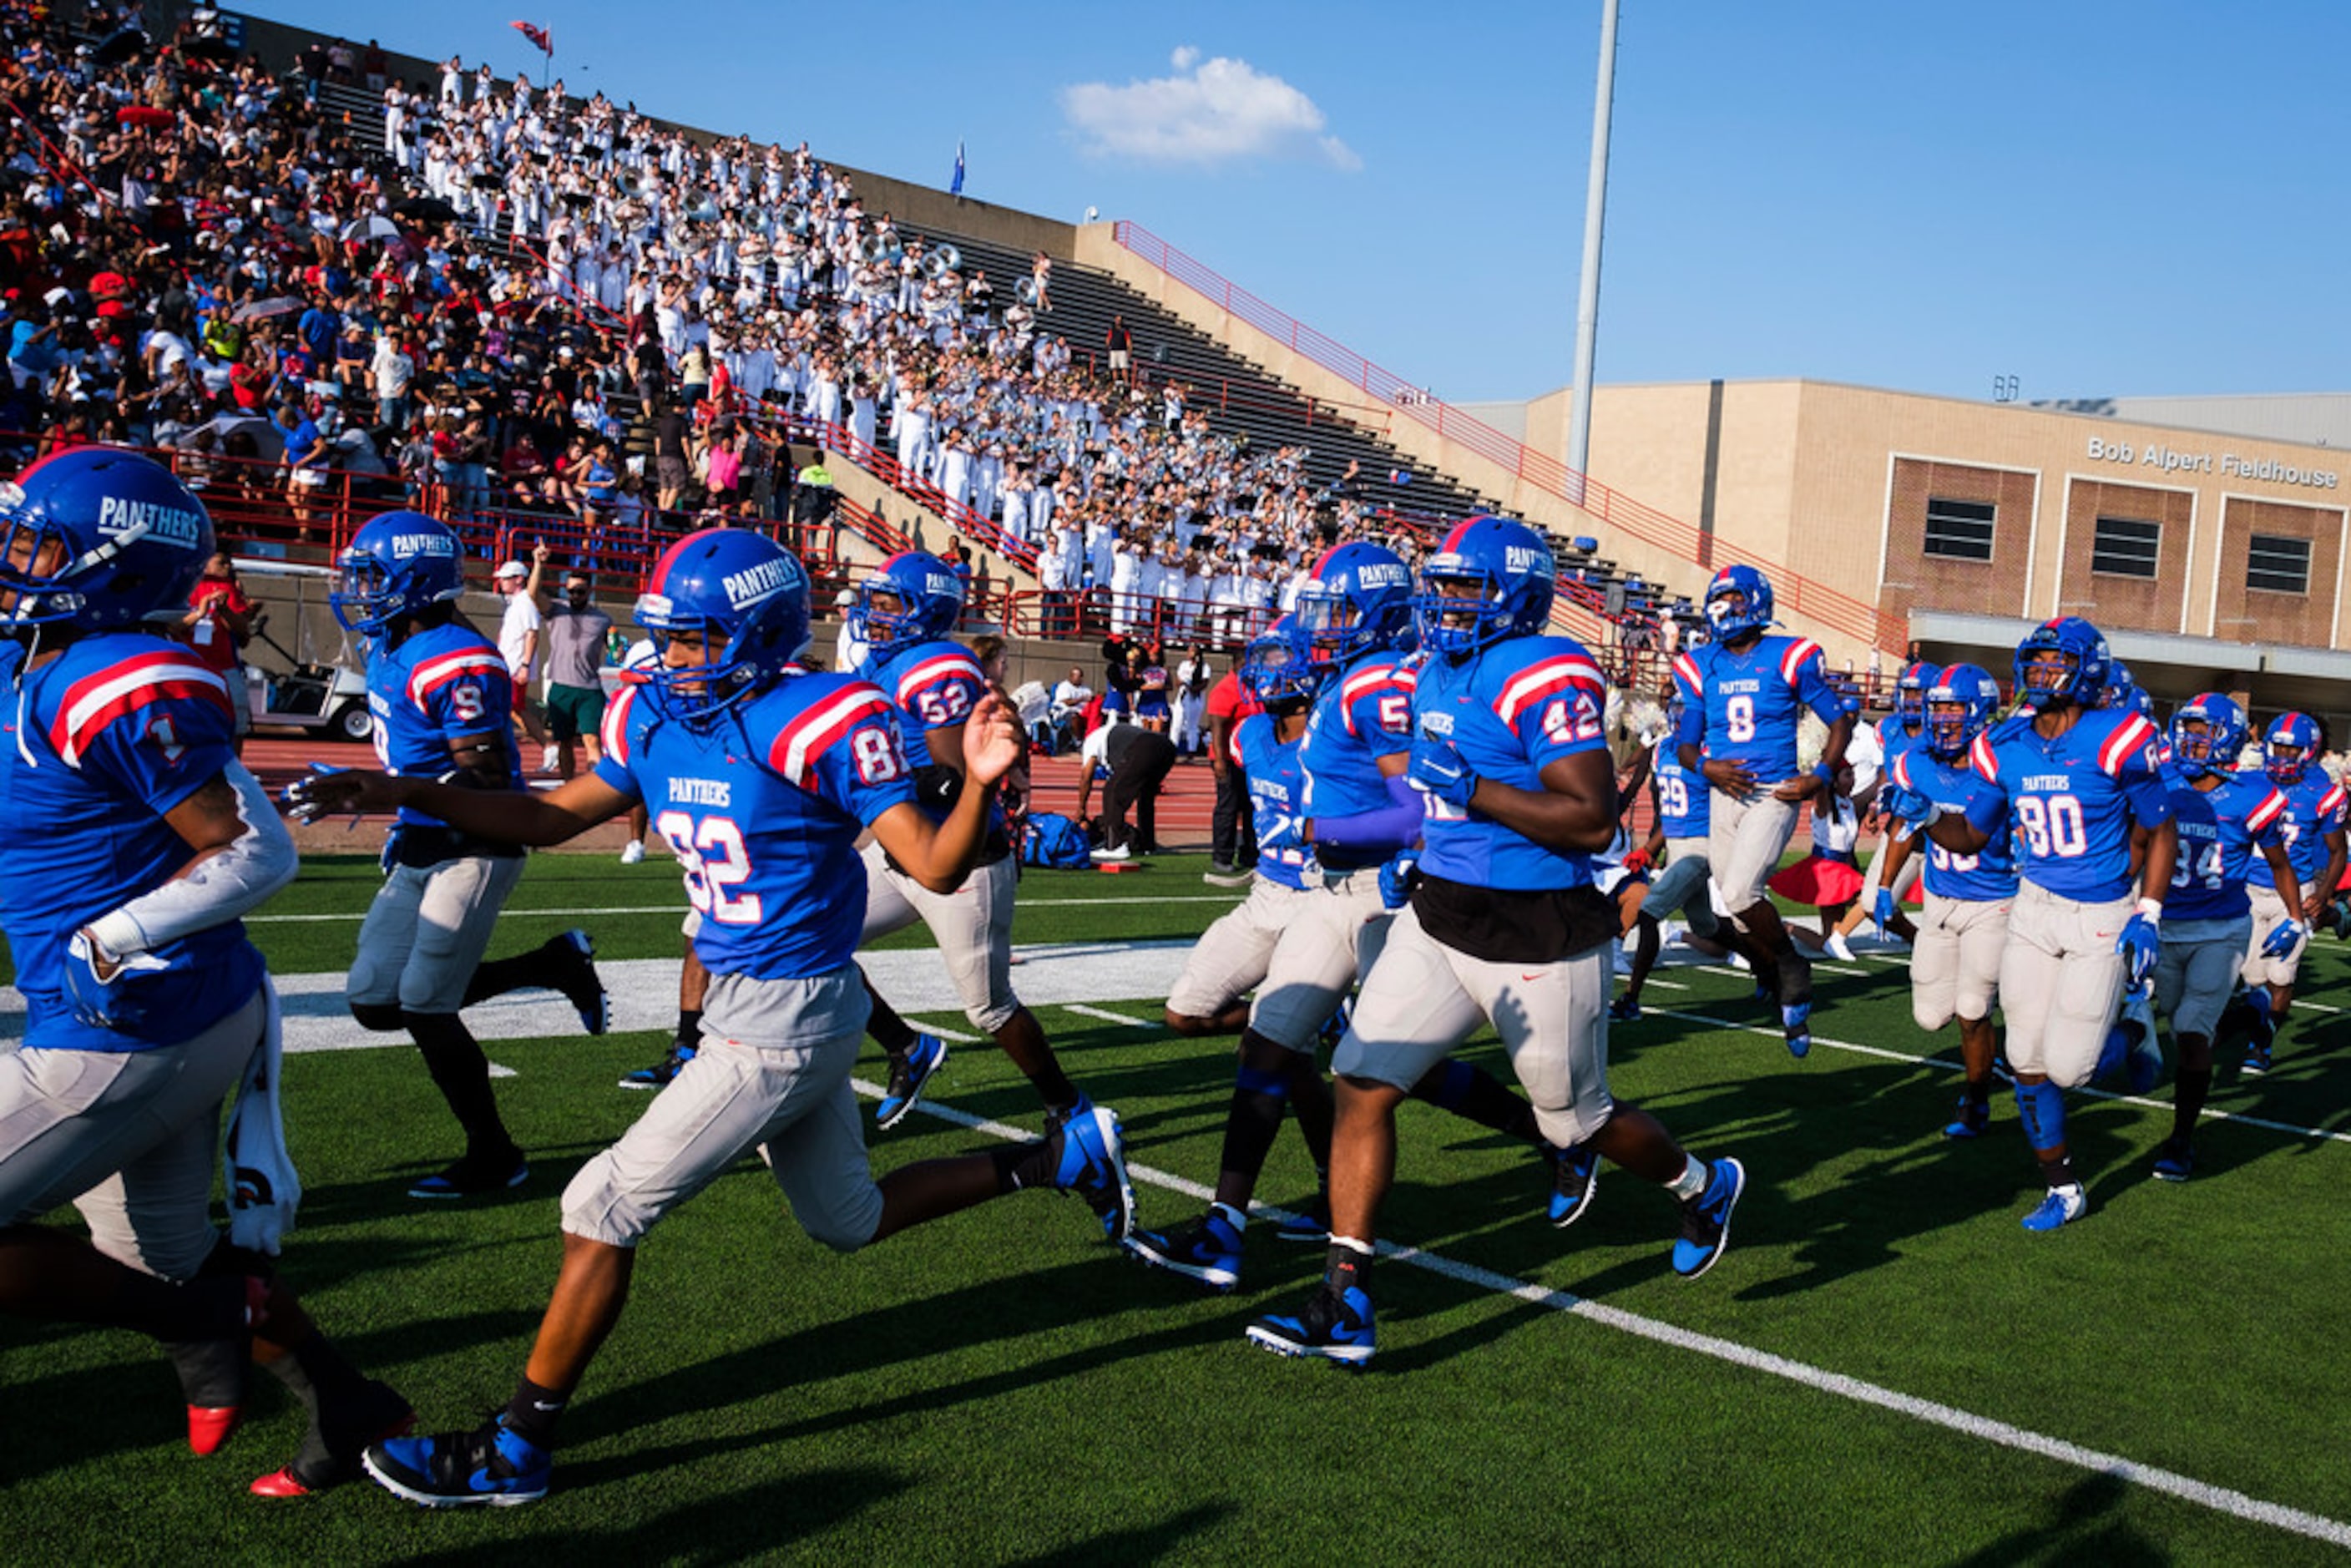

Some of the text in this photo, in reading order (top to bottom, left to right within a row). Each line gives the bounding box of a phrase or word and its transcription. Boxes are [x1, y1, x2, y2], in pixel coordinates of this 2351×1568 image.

[2087, 437, 2338, 488] Bob Alpert Fieldhouse
[99, 494, 200, 543] PANTHERS
[721, 555, 799, 604] PANTHERS
[451, 685, 486, 721] 9
[918, 682, 973, 725] 52
[1540, 690, 1602, 746] 42
[1726, 694, 1757, 743] 8
[144, 712, 189, 767] 1
[668, 776, 731, 808] PANTHERS
[1656, 774, 1689, 817] 29
[2015, 794, 2087, 857] 80
[656, 809, 763, 924] 82
